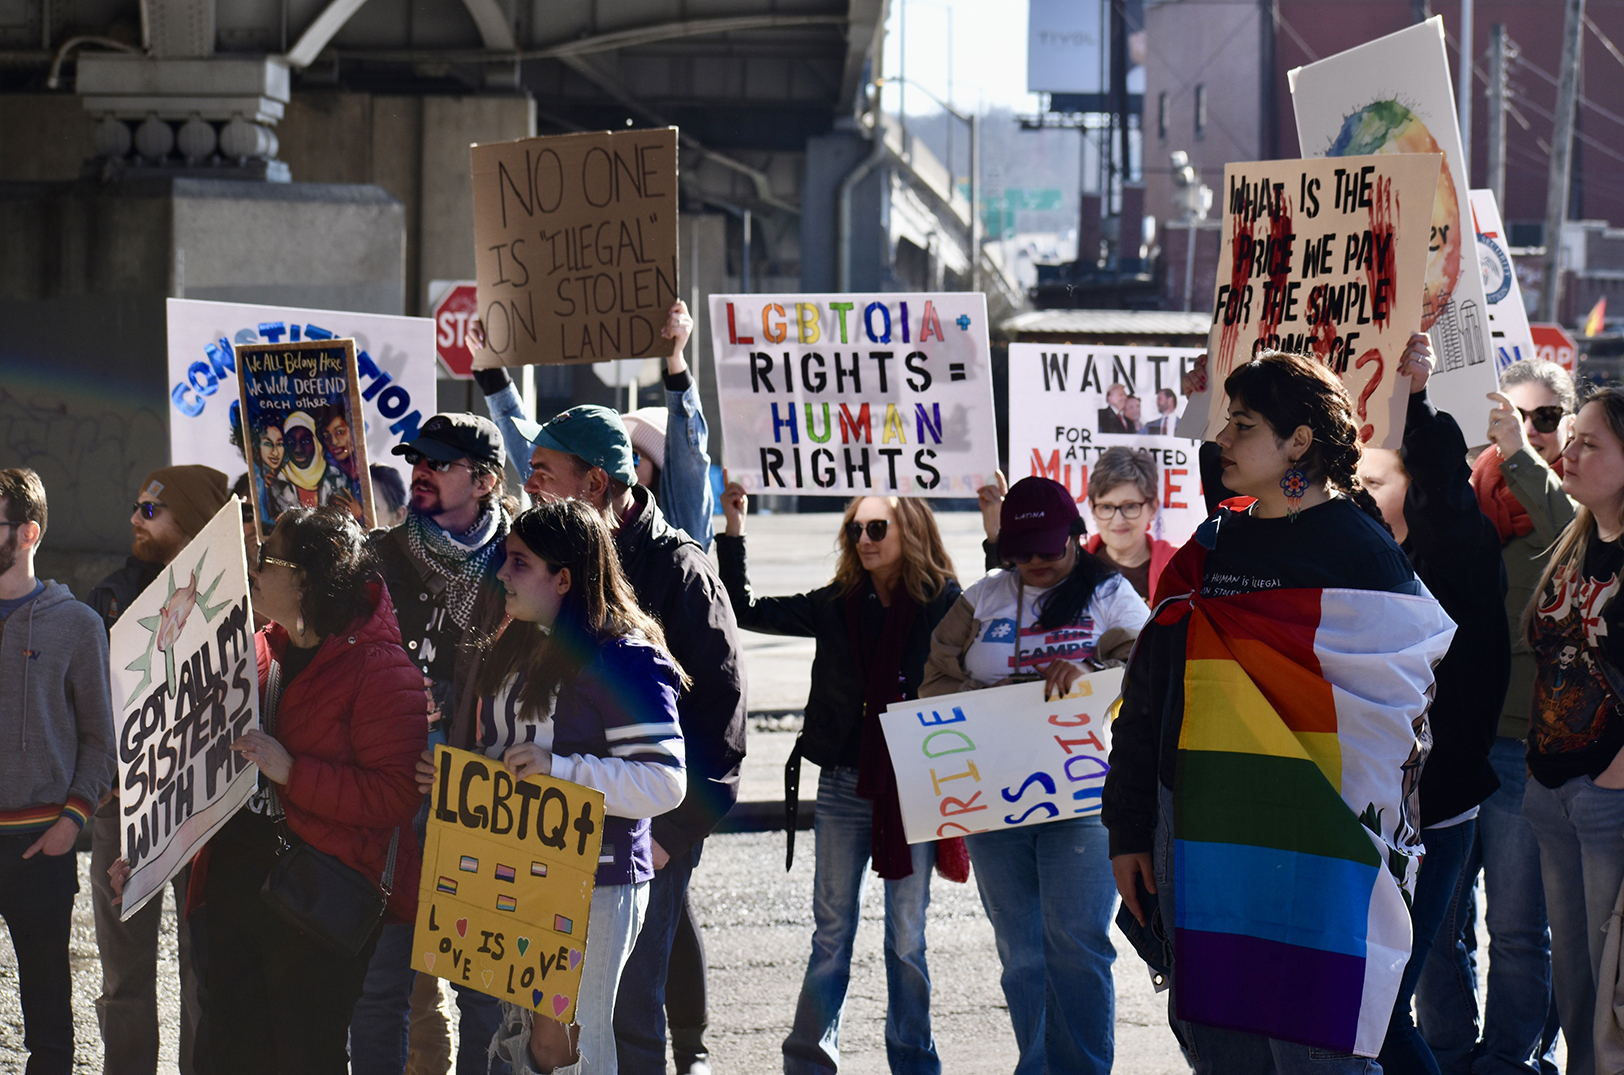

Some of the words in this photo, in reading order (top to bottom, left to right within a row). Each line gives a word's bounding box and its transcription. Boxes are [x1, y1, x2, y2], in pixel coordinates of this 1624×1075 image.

[498, 148, 563, 229] NO
[583, 143, 666, 208] ONE
[1230, 174, 1285, 222] WHAT
[1300, 172, 1321, 219] IS
[1334, 165, 1375, 214] THE
[489, 238, 530, 288] IS
[1237, 233, 1296, 279] PRICE
[1302, 233, 1336, 279] WE
[1343, 229, 1393, 275] PAY
[486, 291, 537, 354] ON
[553, 255, 678, 317] STOLEN
[1213, 283, 1254, 326] FOR
[1261, 281, 1301, 325] THE
[1306, 278, 1391, 326] SIMPLE
[437, 310, 479, 349] ST
[561, 315, 655, 359] LAND
[749, 351, 932, 394] RIGHTS
[949, 363, 966, 381] =
[1041, 352, 1197, 396] WANTE
[1330, 331, 1360, 373] OF
[771, 402, 942, 445] HUMAN
[1055, 426, 1092, 443] FOR
[759, 447, 941, 490] RIGHTS
[1065, 445, 1187, 465] ATTTED
[1014, 511, 1046, 520] LATINA
[1211, 572, 1241, 584] HUMAN
[1019, 641, 1094, 662] CAMPS
[120, 680, 170, 764] GOT
[174, 641, 221, 721] ALL
[216, 594, 248, 677] MY
[124, 657, 251, 817] SISTERS
[126, 763, 194, 870] WITH
[206, 707, 253, 801] ME
[435, 750, 595, 856] LGBTQ+
[429, 904, 472, 980] LOVE
[477, 930, 505, 961] IS
[507, 945, 569, 994] LOVE
